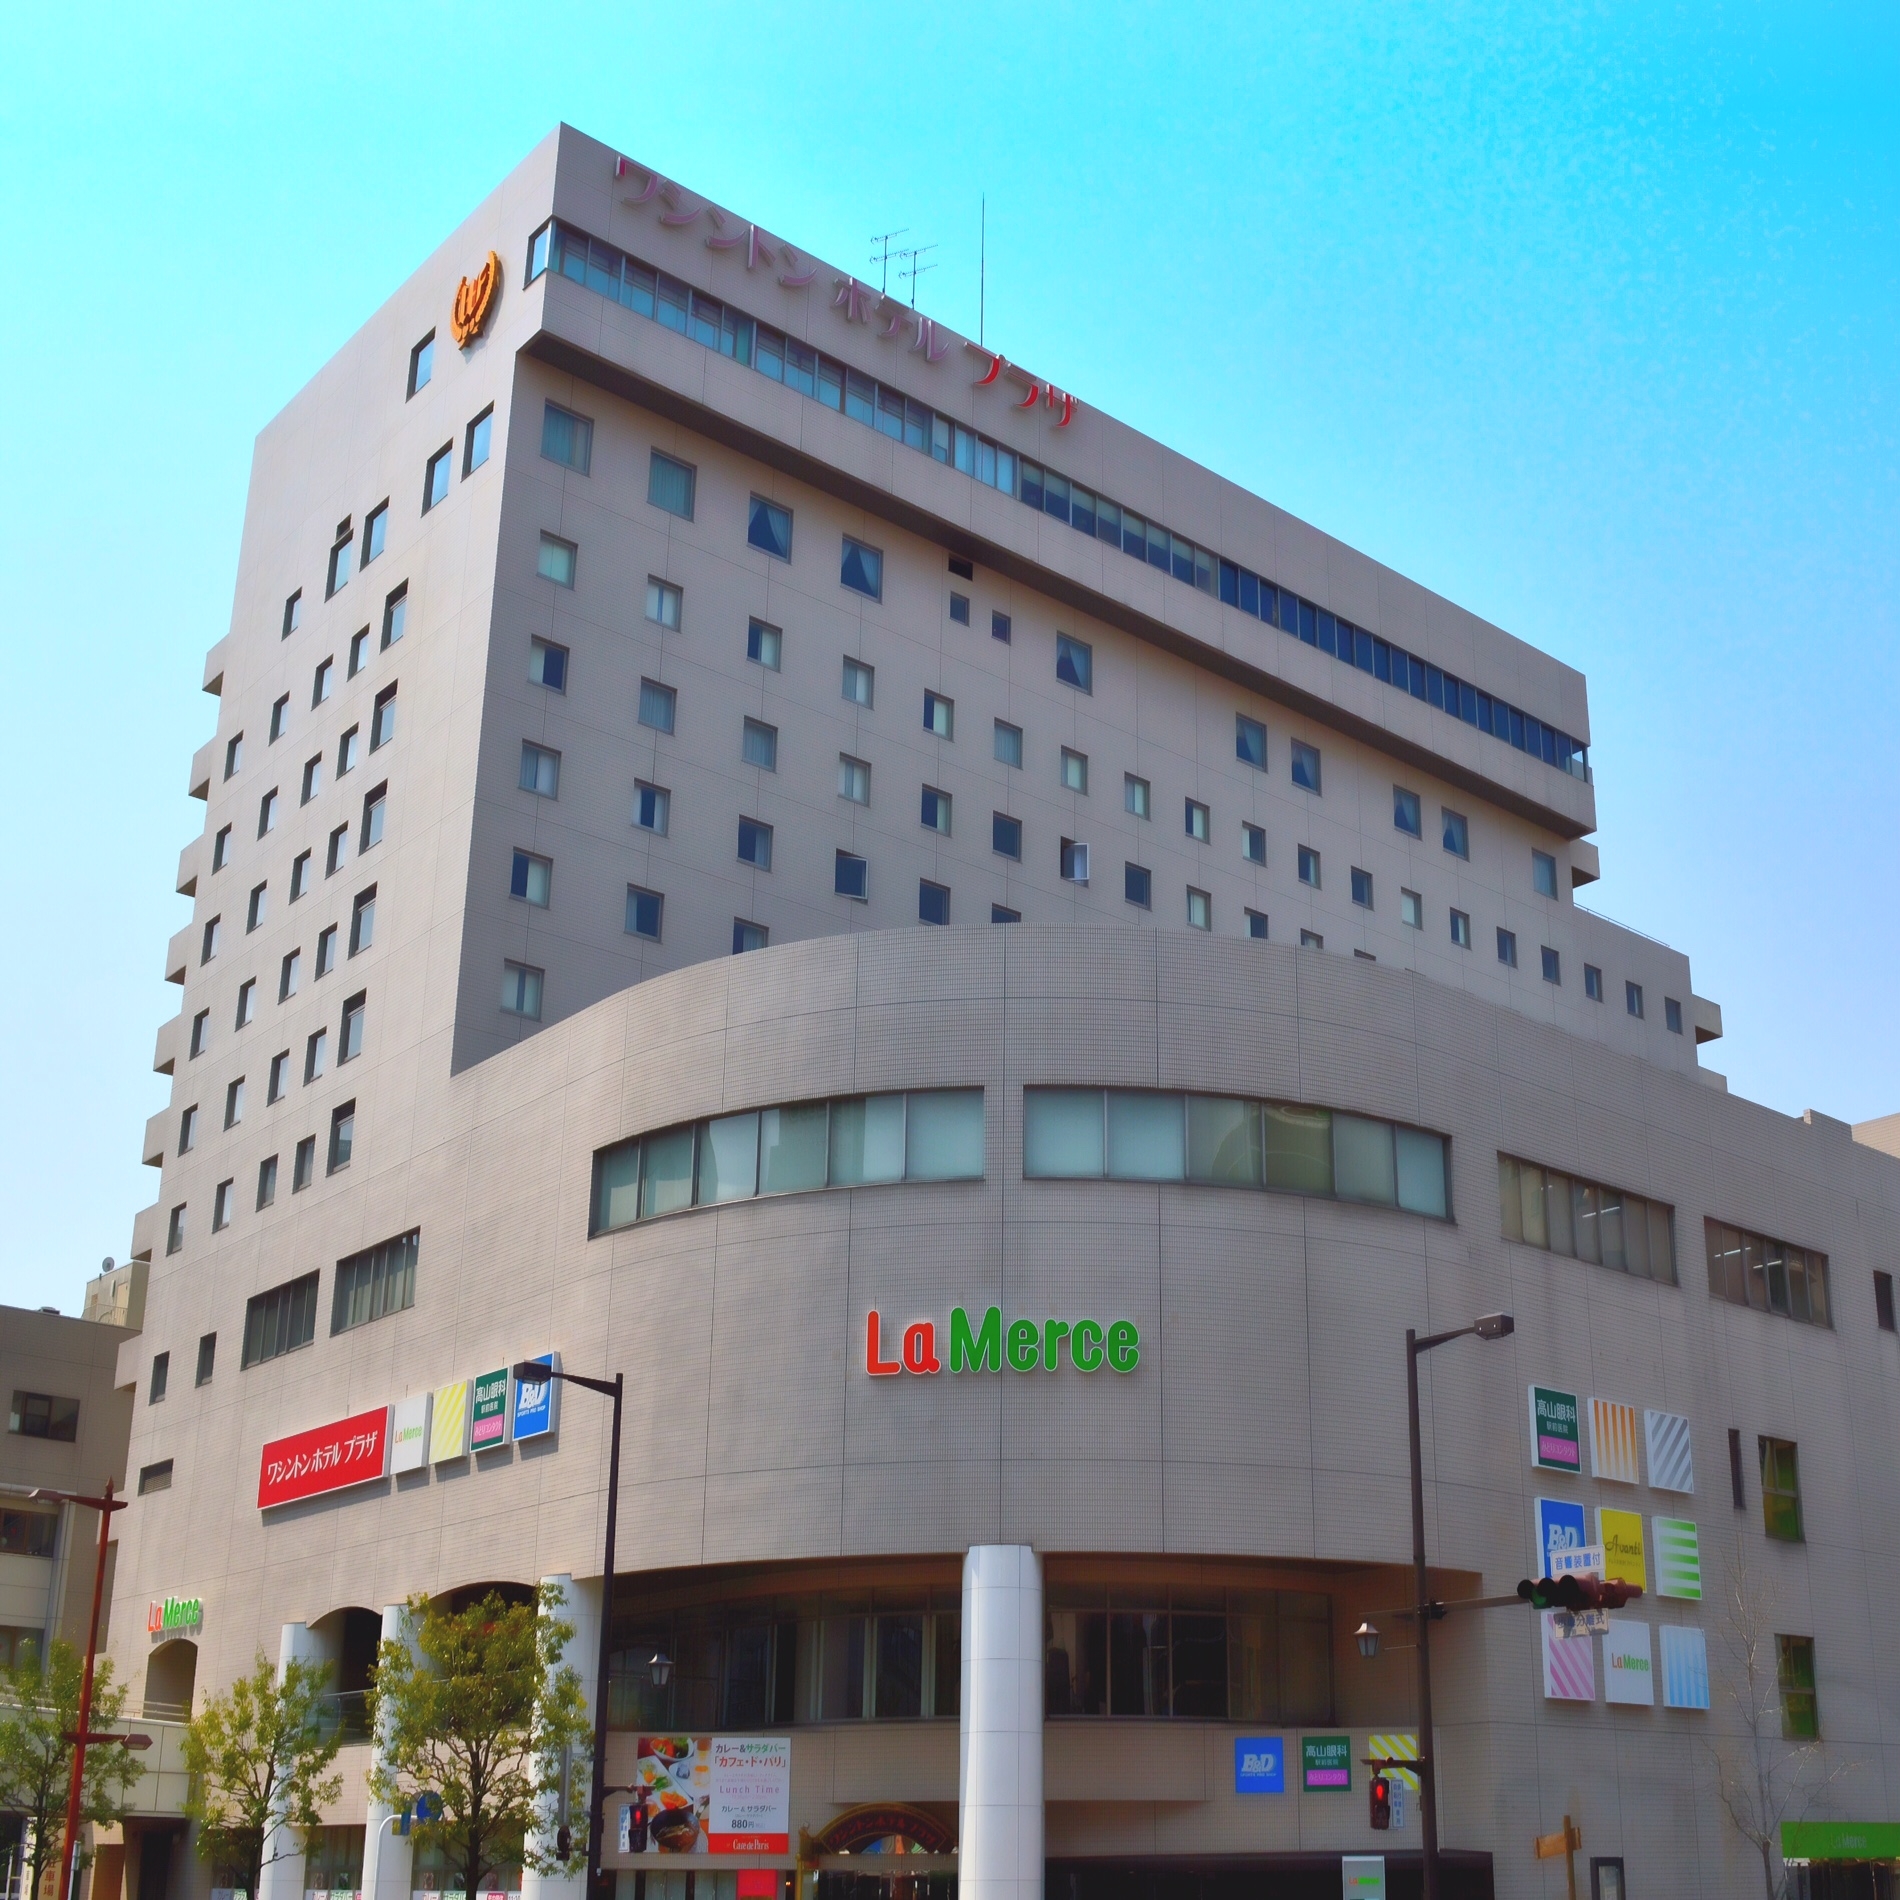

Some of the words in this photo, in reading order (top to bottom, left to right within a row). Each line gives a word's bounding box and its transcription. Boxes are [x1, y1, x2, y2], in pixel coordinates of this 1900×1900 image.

[1536, 1399, 1576, 1423] 高山眼科
[1547, 1523, 1579, 1551] B&D
[1605, 1534, 1642, 1556] Avanti
[1305, 1744, 1348, 1758] 高山眼科
[1241, 1753, 1276, 1773] B&D
[719, 1785, 750, 1794] Lunch
[756, 1785, 780, 1794] Time
